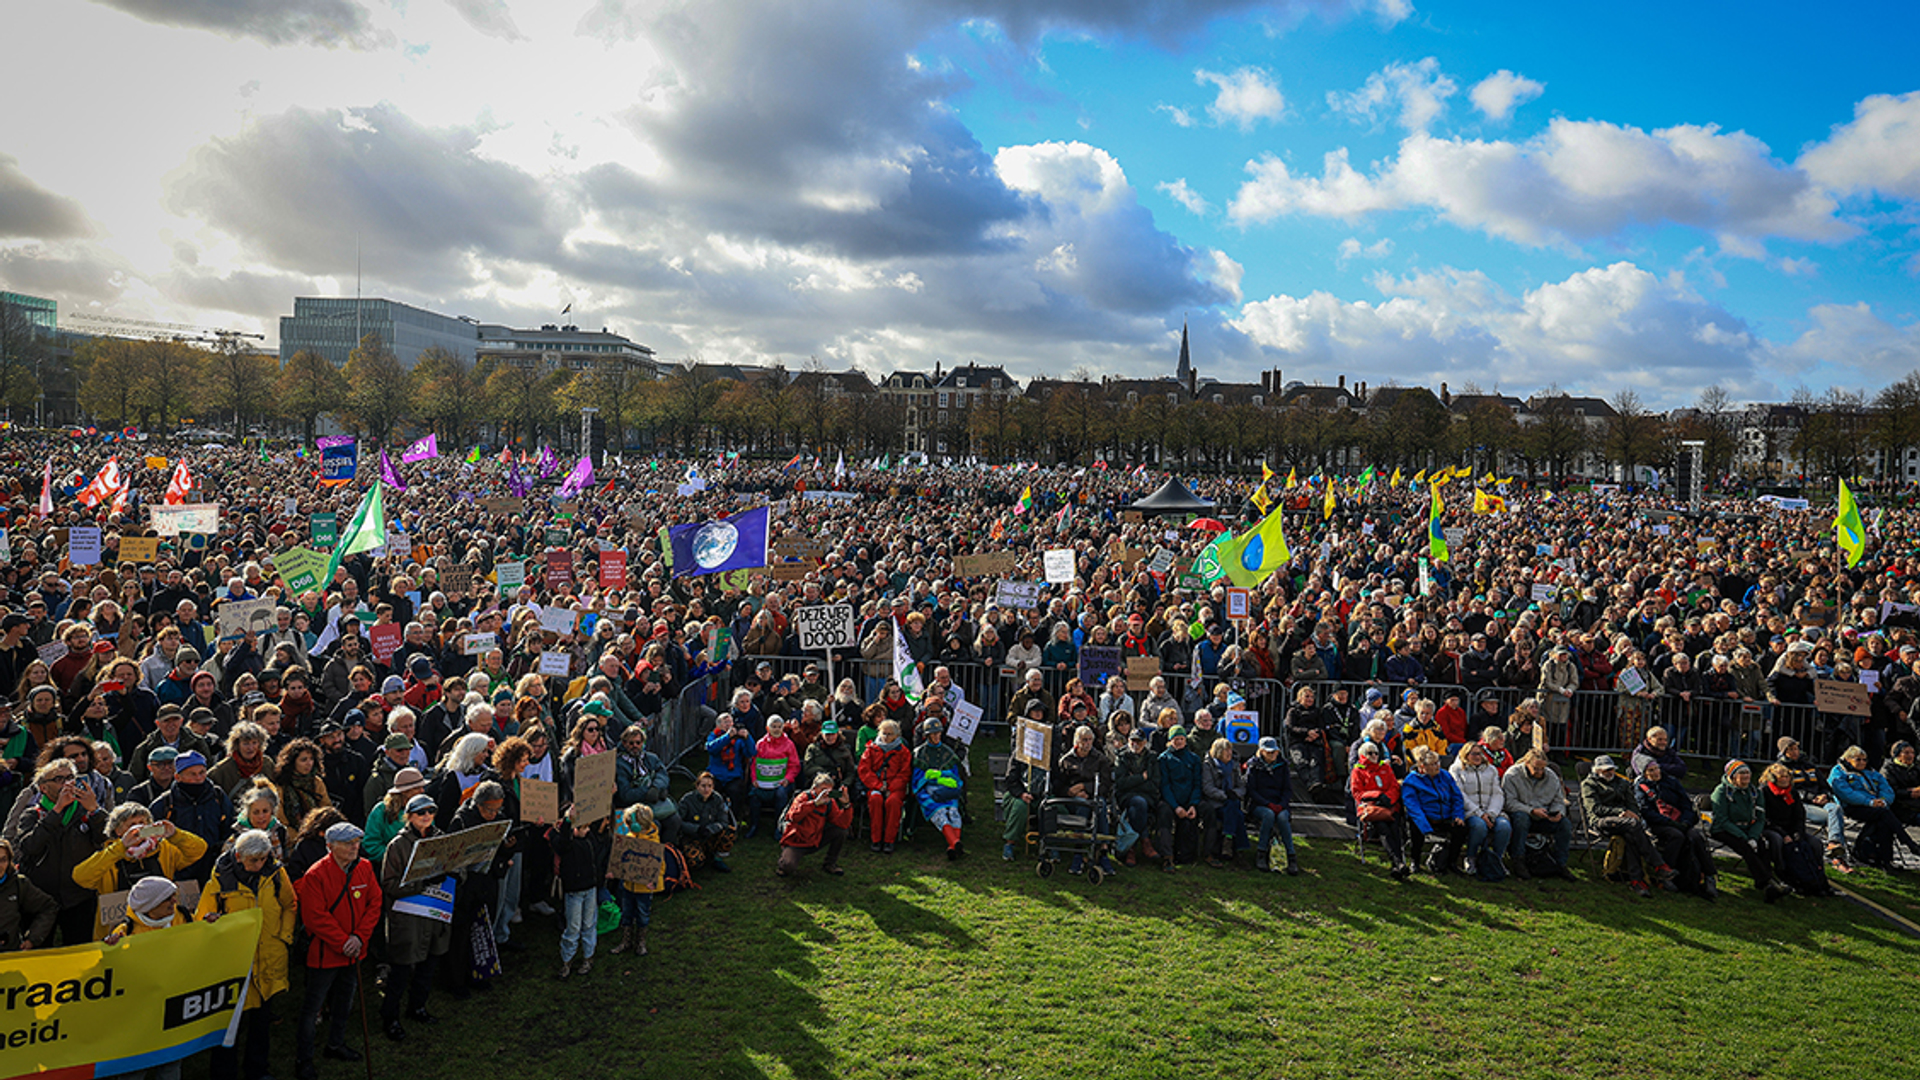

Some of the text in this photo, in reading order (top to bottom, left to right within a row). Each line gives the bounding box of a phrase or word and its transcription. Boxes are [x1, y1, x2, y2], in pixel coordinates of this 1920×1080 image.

[316, 534, 333, 542] D66
[292, 574, 313, 589] D66
[799, 606, 850, 622] DEZE WEG
[809, 618, 847, 631] LOOPT
[803, 630, 847, 647] DOOD
[1081, 646, 1119, 658] CLIMATE
[1082, 660, 1116, 670] JUSTICE
[102, 902, 128, 922] FOSS
[182, 982, 240, 1020] BIJ1
